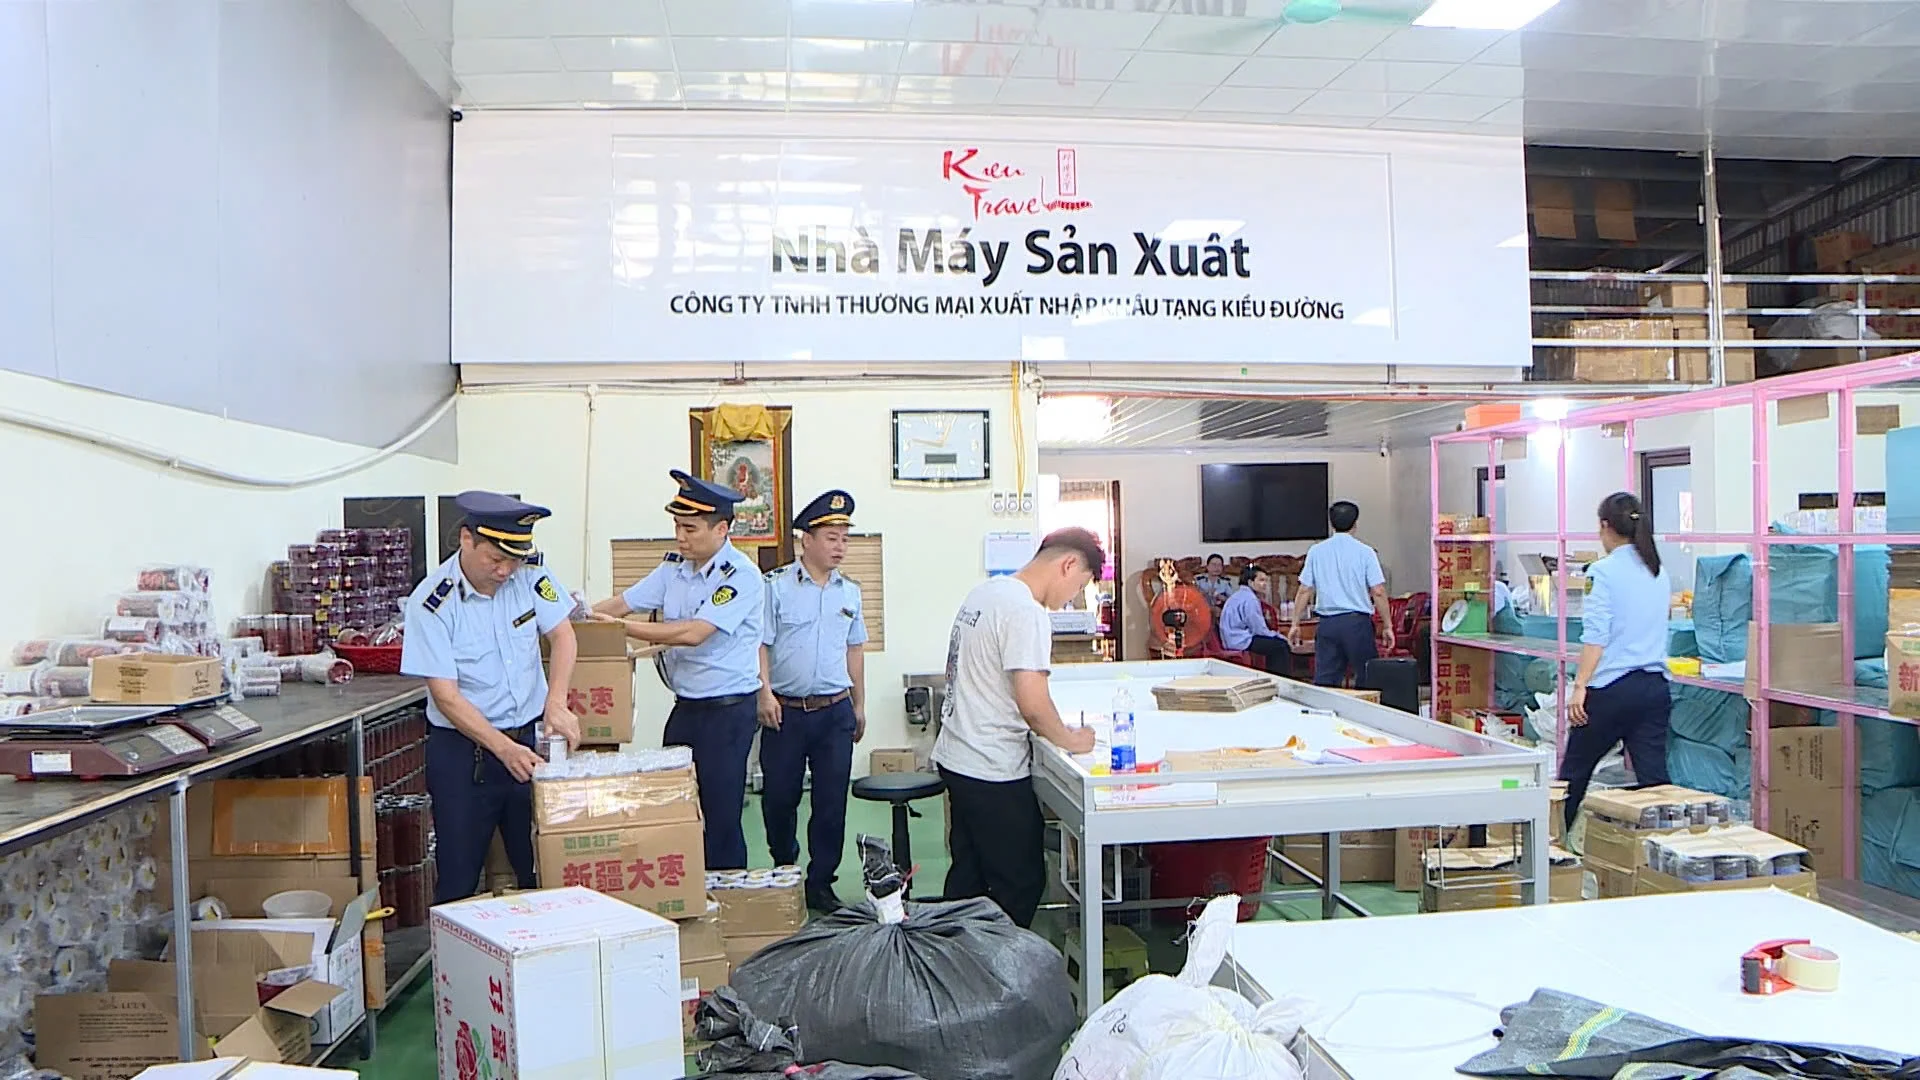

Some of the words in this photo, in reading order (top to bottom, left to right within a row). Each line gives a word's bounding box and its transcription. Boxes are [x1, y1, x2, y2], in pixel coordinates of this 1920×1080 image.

[772, 225, 880, 273] Nhà
[897, 227, 1010, 287] Máy
[1025, 224, 1118, 275] Sản
[670, 291, 733, 314] CÔNG
[738, 296, 765, 314] TY
[771, 296, 831, 314] TNHH
[836, 293, 929, 315] THƯƠNG
[935, 296, 974, 318] MẠI
[980, 290, 1034, 315] XUẤT
[1163, 298, 1216, 319] TẠNG
[1269, 296, 1344, 320] ĐƯỜNG
[562, 854, 686, 893] 新疆大枣
